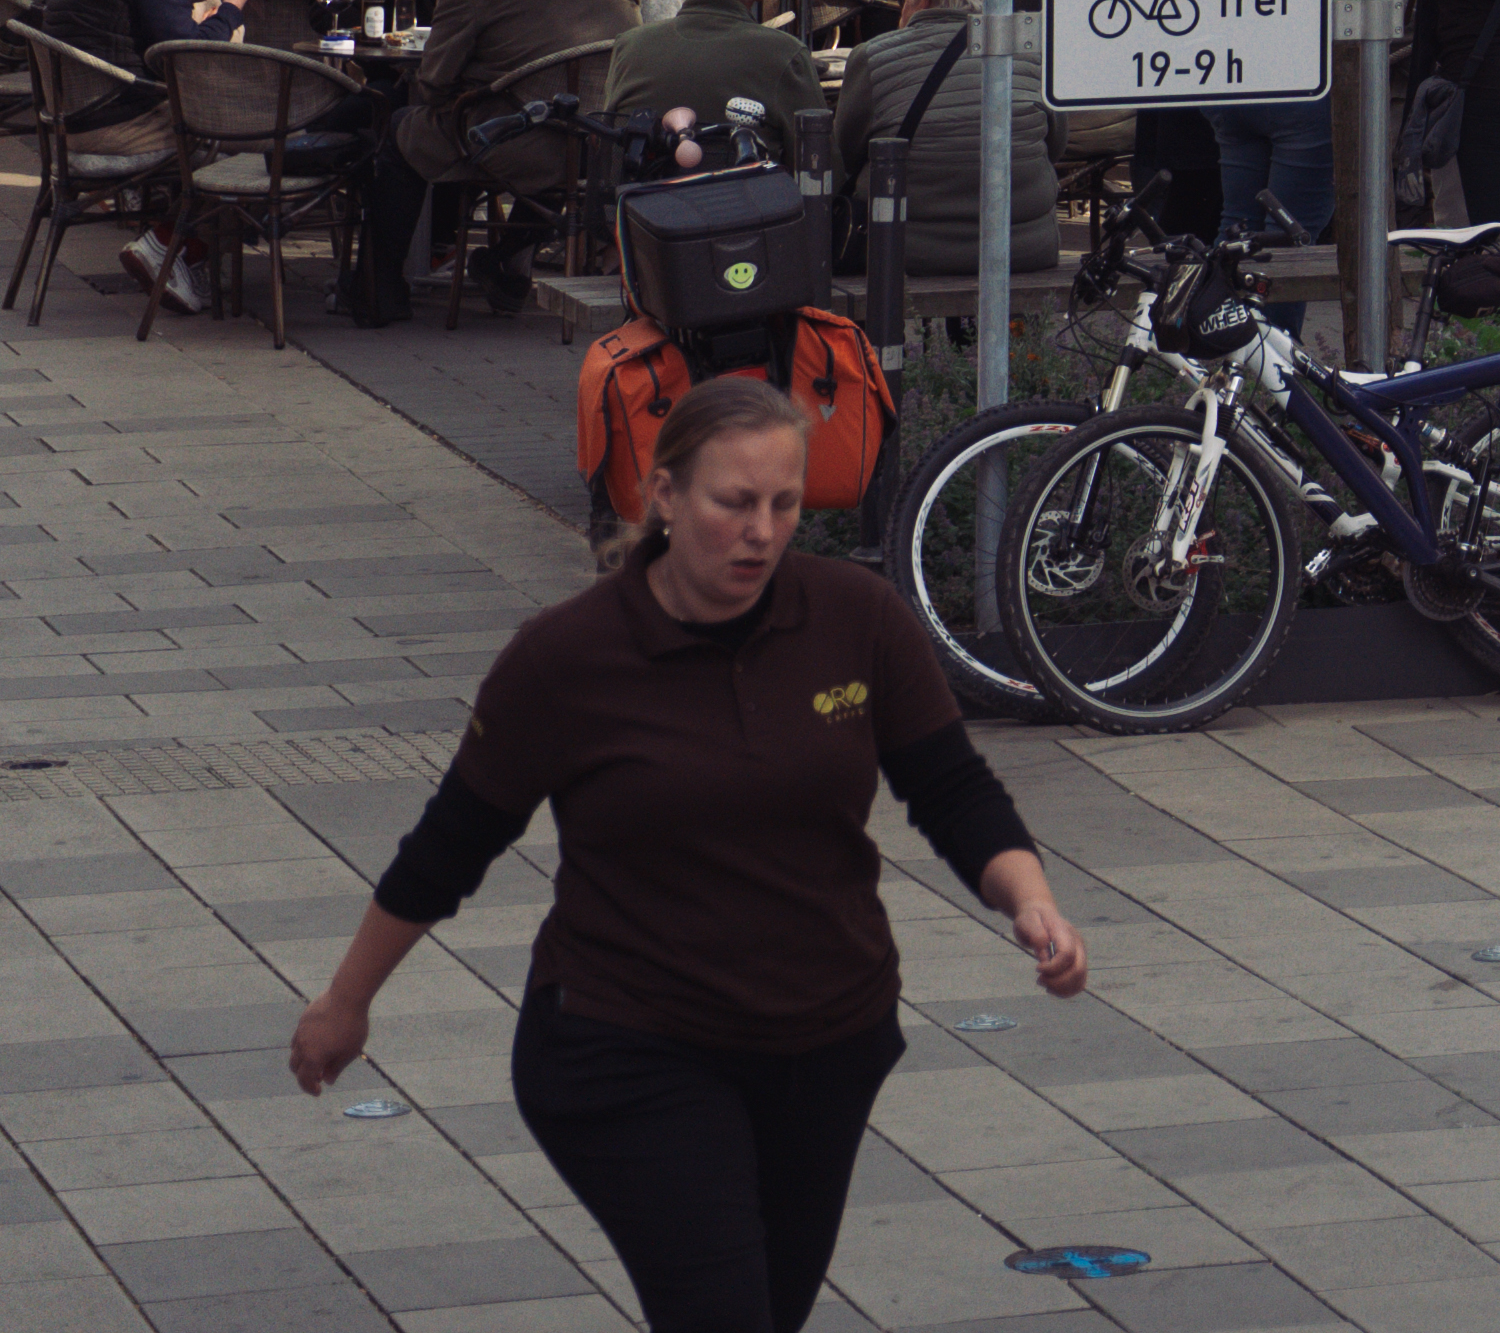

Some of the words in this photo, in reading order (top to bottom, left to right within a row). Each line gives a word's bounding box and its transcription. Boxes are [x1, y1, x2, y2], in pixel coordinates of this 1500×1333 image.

[1132, 48, 1216, 87] 19-9
[1227, 48, 1243, 84] h
[1198, 303, 1250, 334] WHEE
